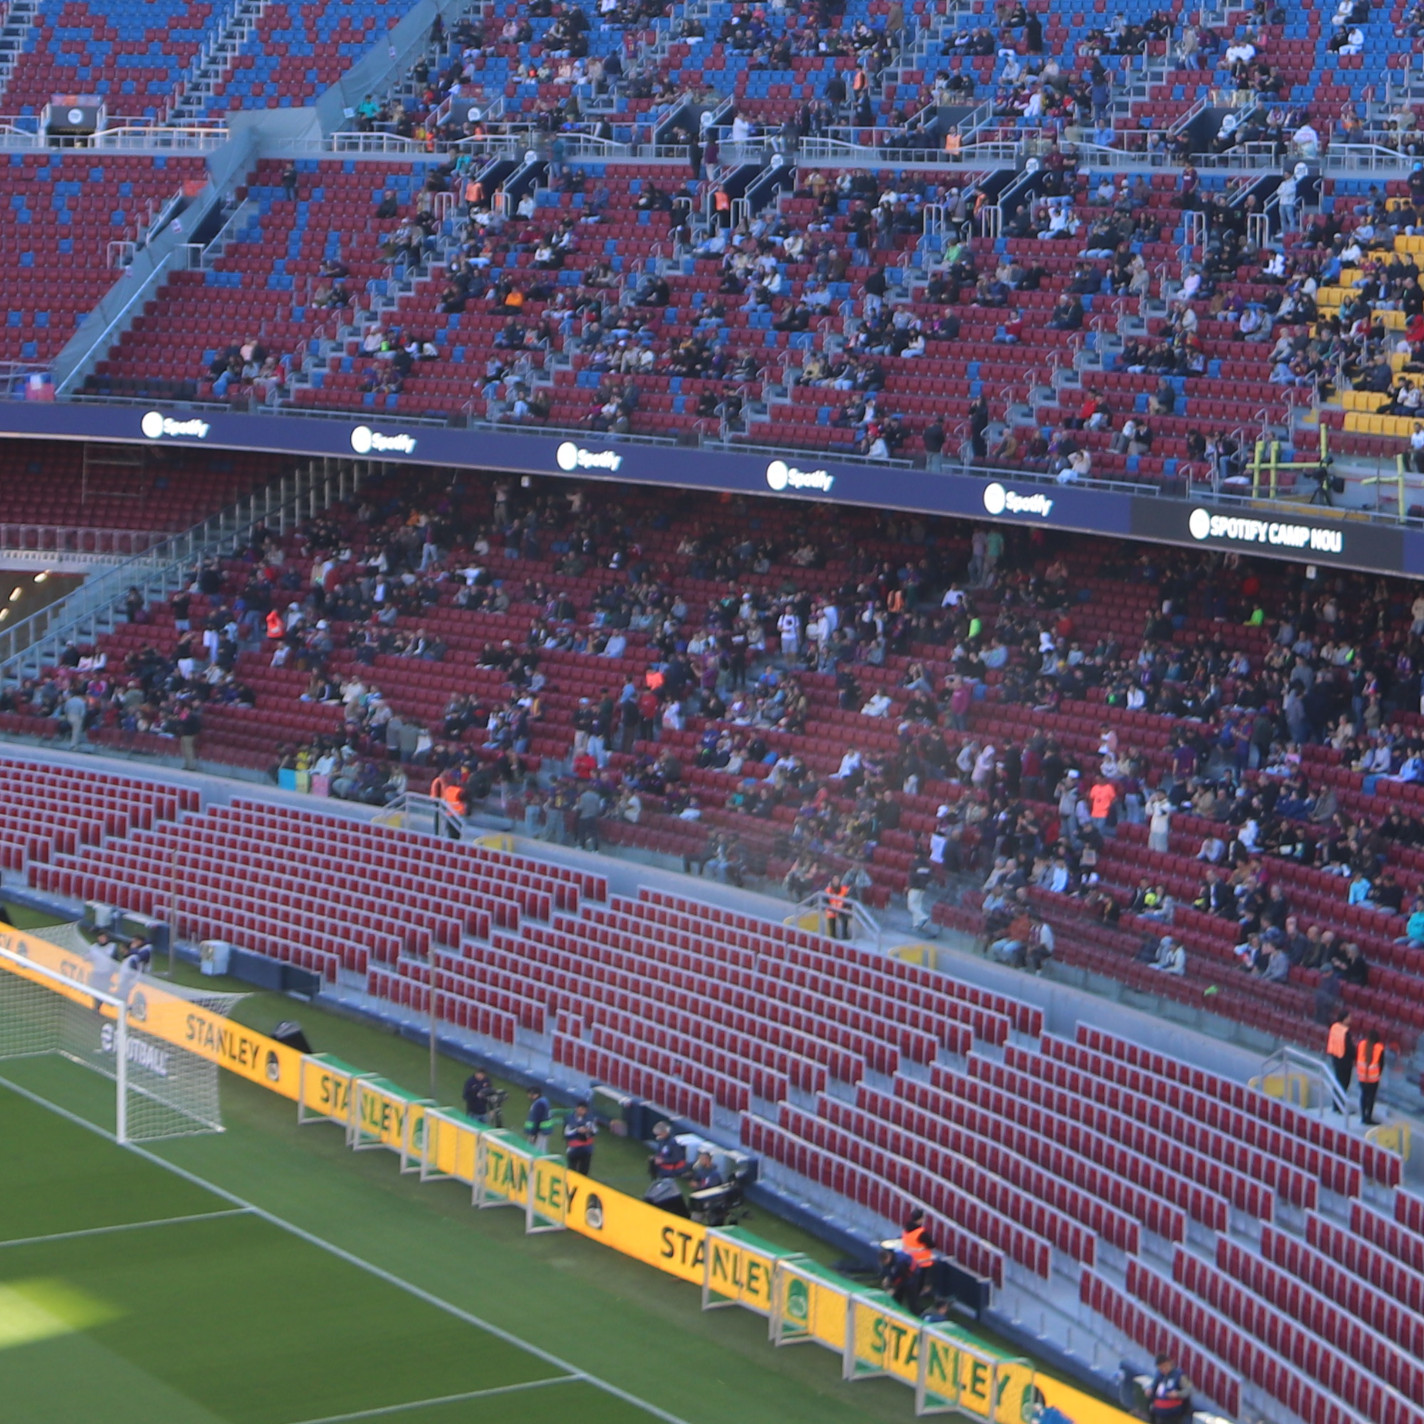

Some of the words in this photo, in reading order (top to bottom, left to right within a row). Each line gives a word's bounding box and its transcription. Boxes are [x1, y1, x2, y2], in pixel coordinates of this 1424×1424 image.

[163, 418, 210, 438] Spotify
[371, 432, 417, 454] Spotify
[577, 448, 623, 471] Spotify
[788, 468, 834, 492] Spotify
[1006, 491, 1053, 517] Spotify
[1210, 515, 1268, 543] SPOTIFY
[1268, 522, 1310, 548] CAMP
[1311, 528, 1343, 553] NOU
[186, 1014, 261, 1062] STANLEY
